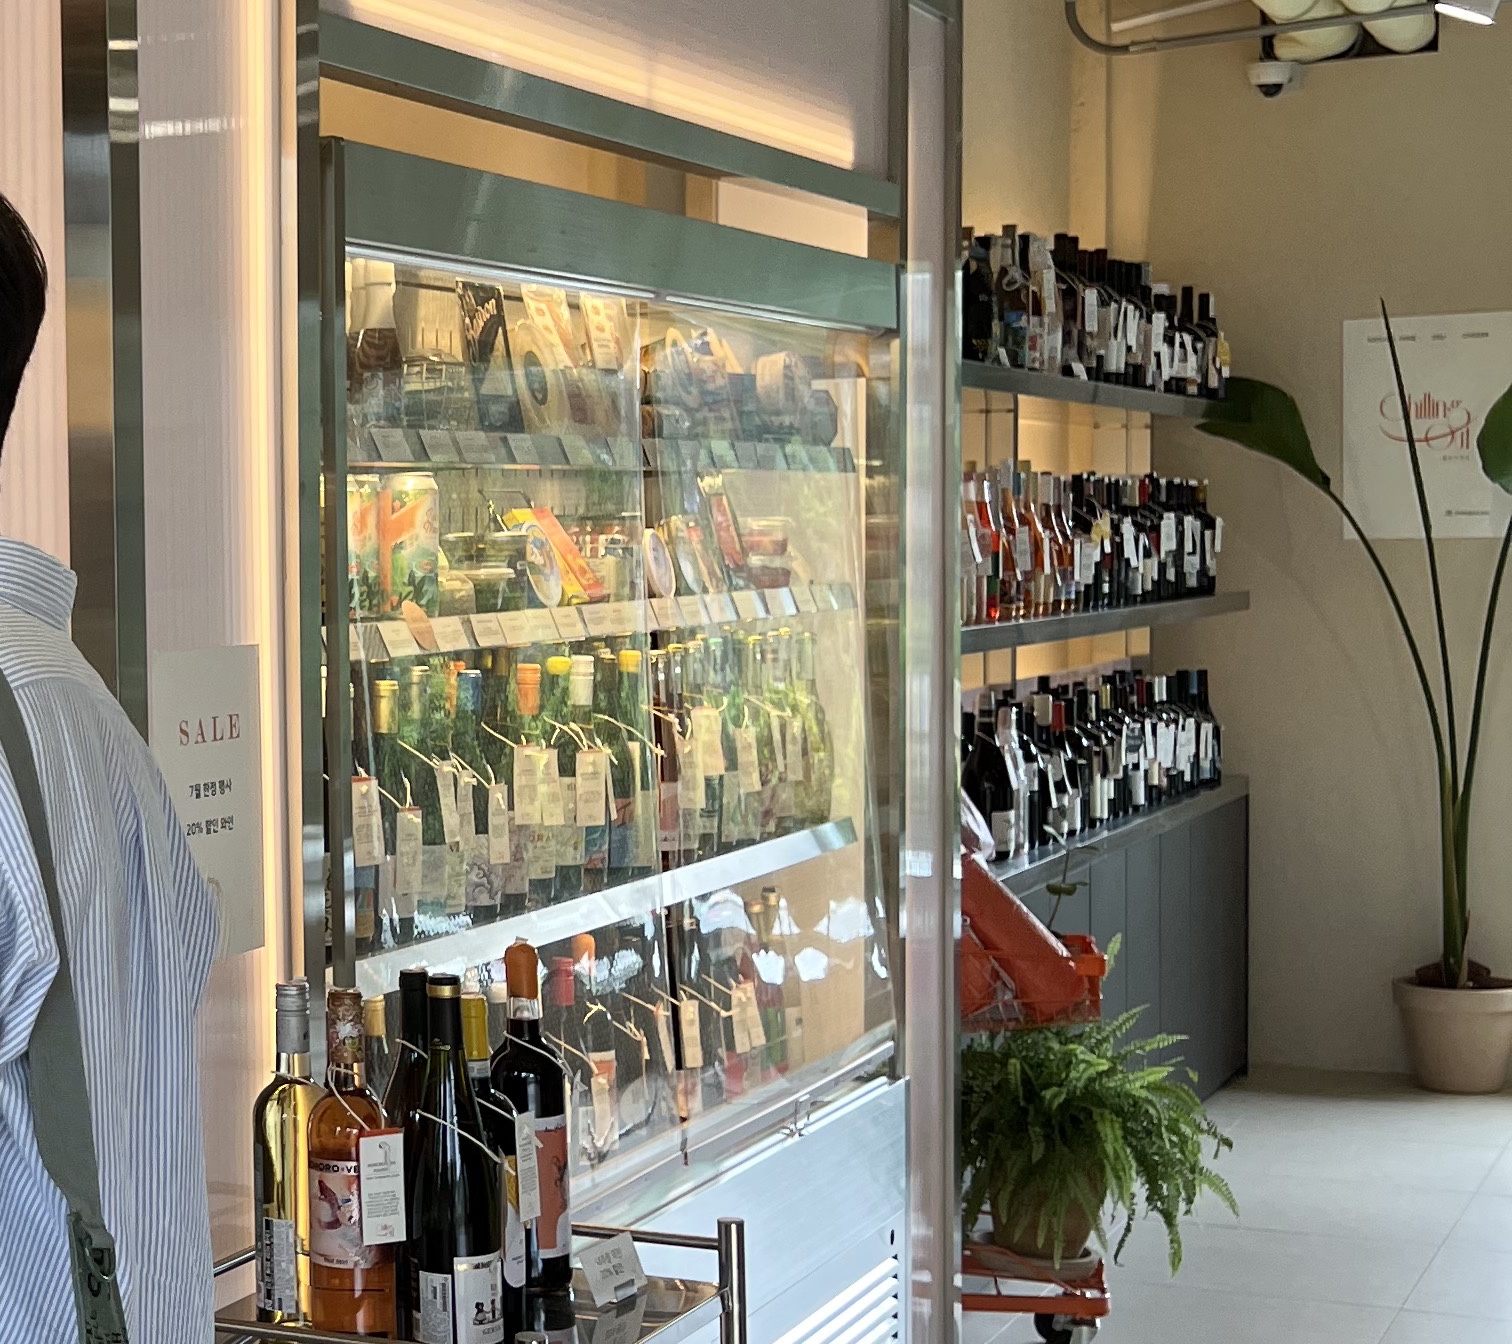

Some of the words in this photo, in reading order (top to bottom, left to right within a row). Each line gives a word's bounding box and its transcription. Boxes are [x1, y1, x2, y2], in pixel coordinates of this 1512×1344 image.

[179, 713, 241, 747] SALE
[189, 783, 201, 799] 7월
[203, 781, 217, 798] 한정
[218, 778, 232, 795] 행사
[186, 821, 203, 837] 20%
[205, 818, 219, 835] 할인
[220, 815, 234, 831] 와인
